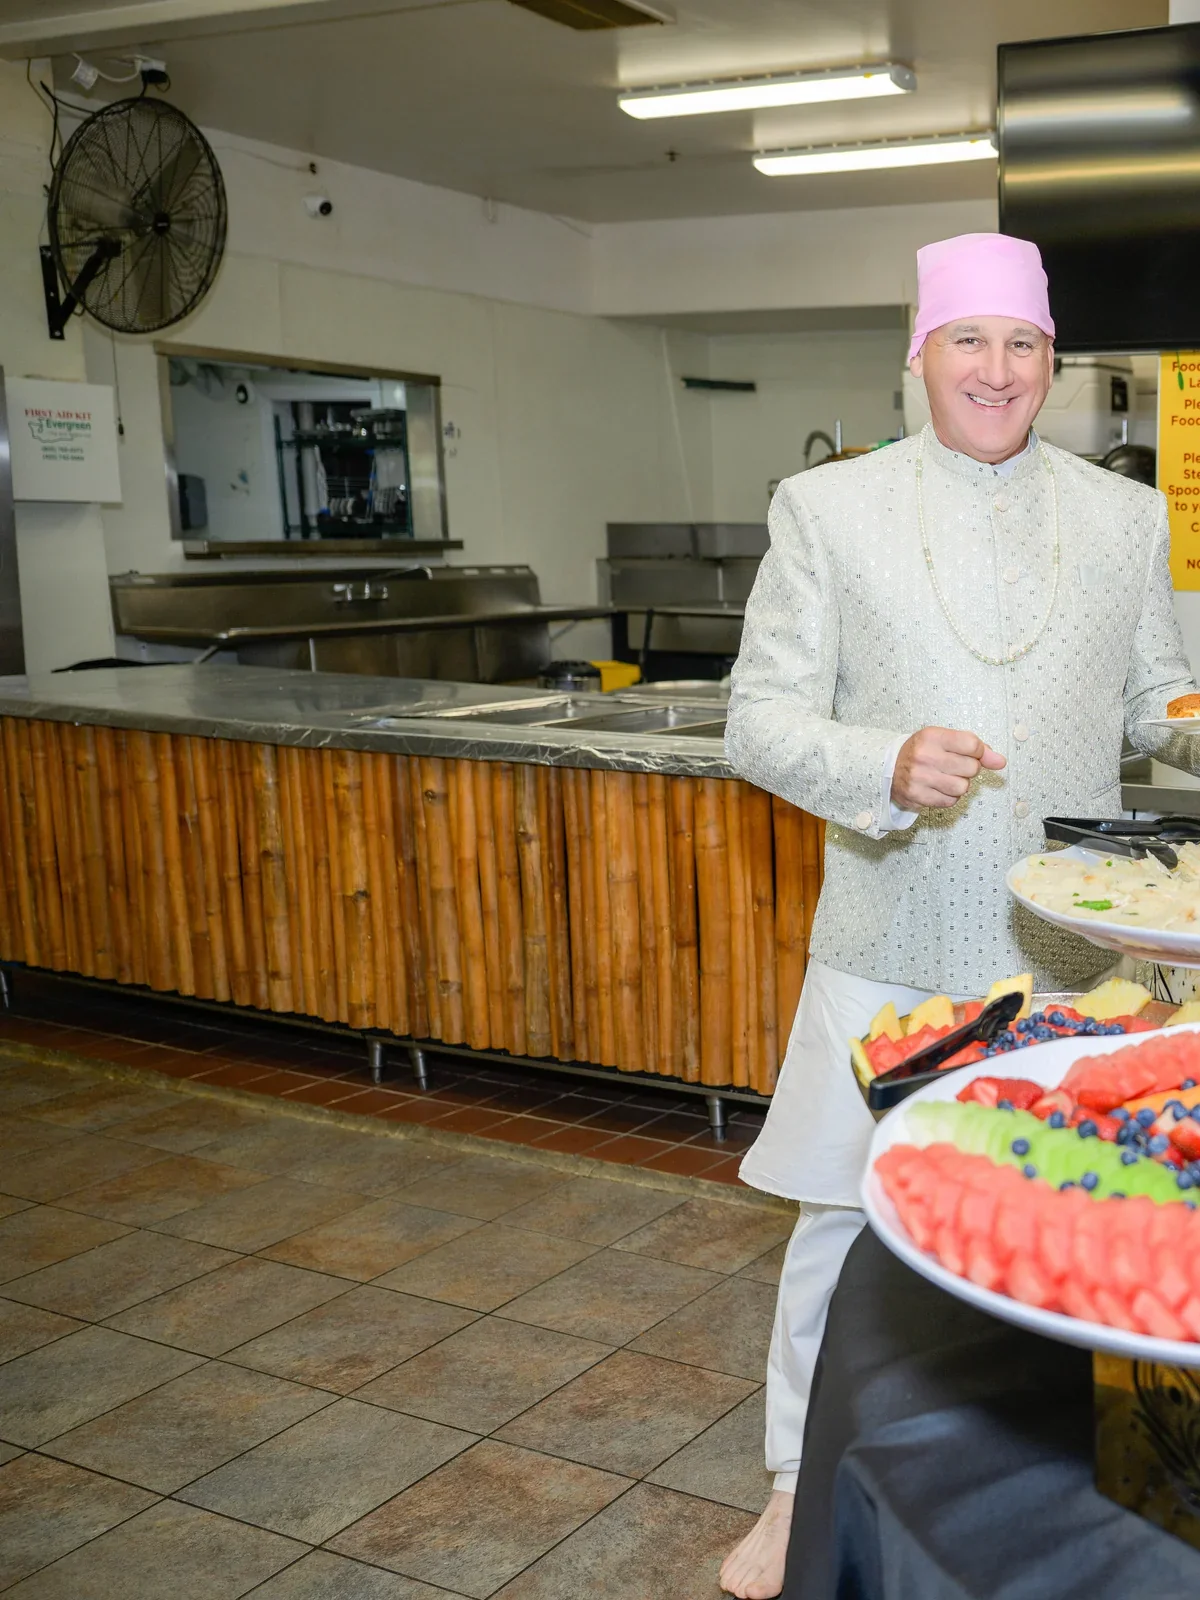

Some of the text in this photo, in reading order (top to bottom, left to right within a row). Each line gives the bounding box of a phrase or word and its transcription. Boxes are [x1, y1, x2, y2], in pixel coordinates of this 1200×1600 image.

[56, 411, 73, 420] AID
[75, 412, 92, 421] KIT
[46, 419, 91, 431] Evergreen
[1175, 502, 1187, 512] to
